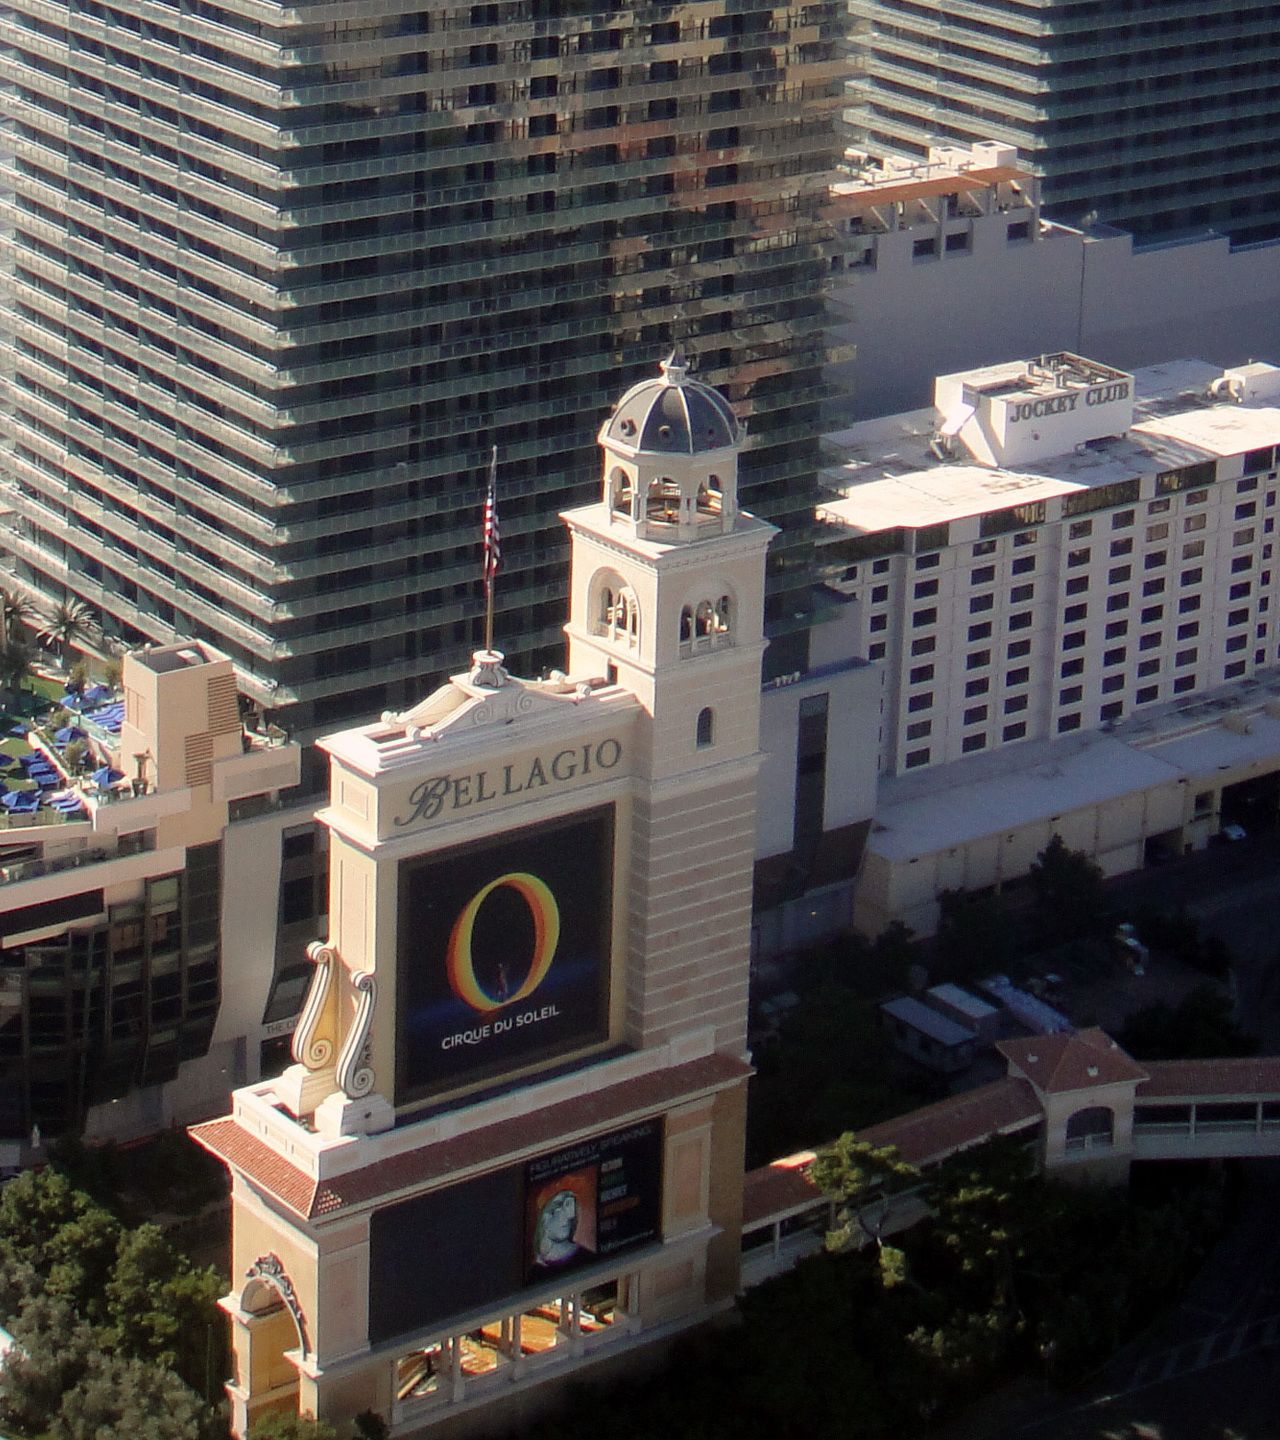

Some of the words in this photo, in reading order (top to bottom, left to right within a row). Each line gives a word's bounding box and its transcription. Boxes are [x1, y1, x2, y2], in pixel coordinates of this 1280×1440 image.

[1010, 393, 1079, 422] JOCKEY
[1086, 382, 1129, 406] CLUB
[394, 738, 622, 827] BELLAGIO
[446, 872, 560, 1011] O
[441, 1024, 491, 1050] CIRQUE
[494, 1017, 513, 1034] DU
[516, 1004, 560, 1027] SOLEIL
